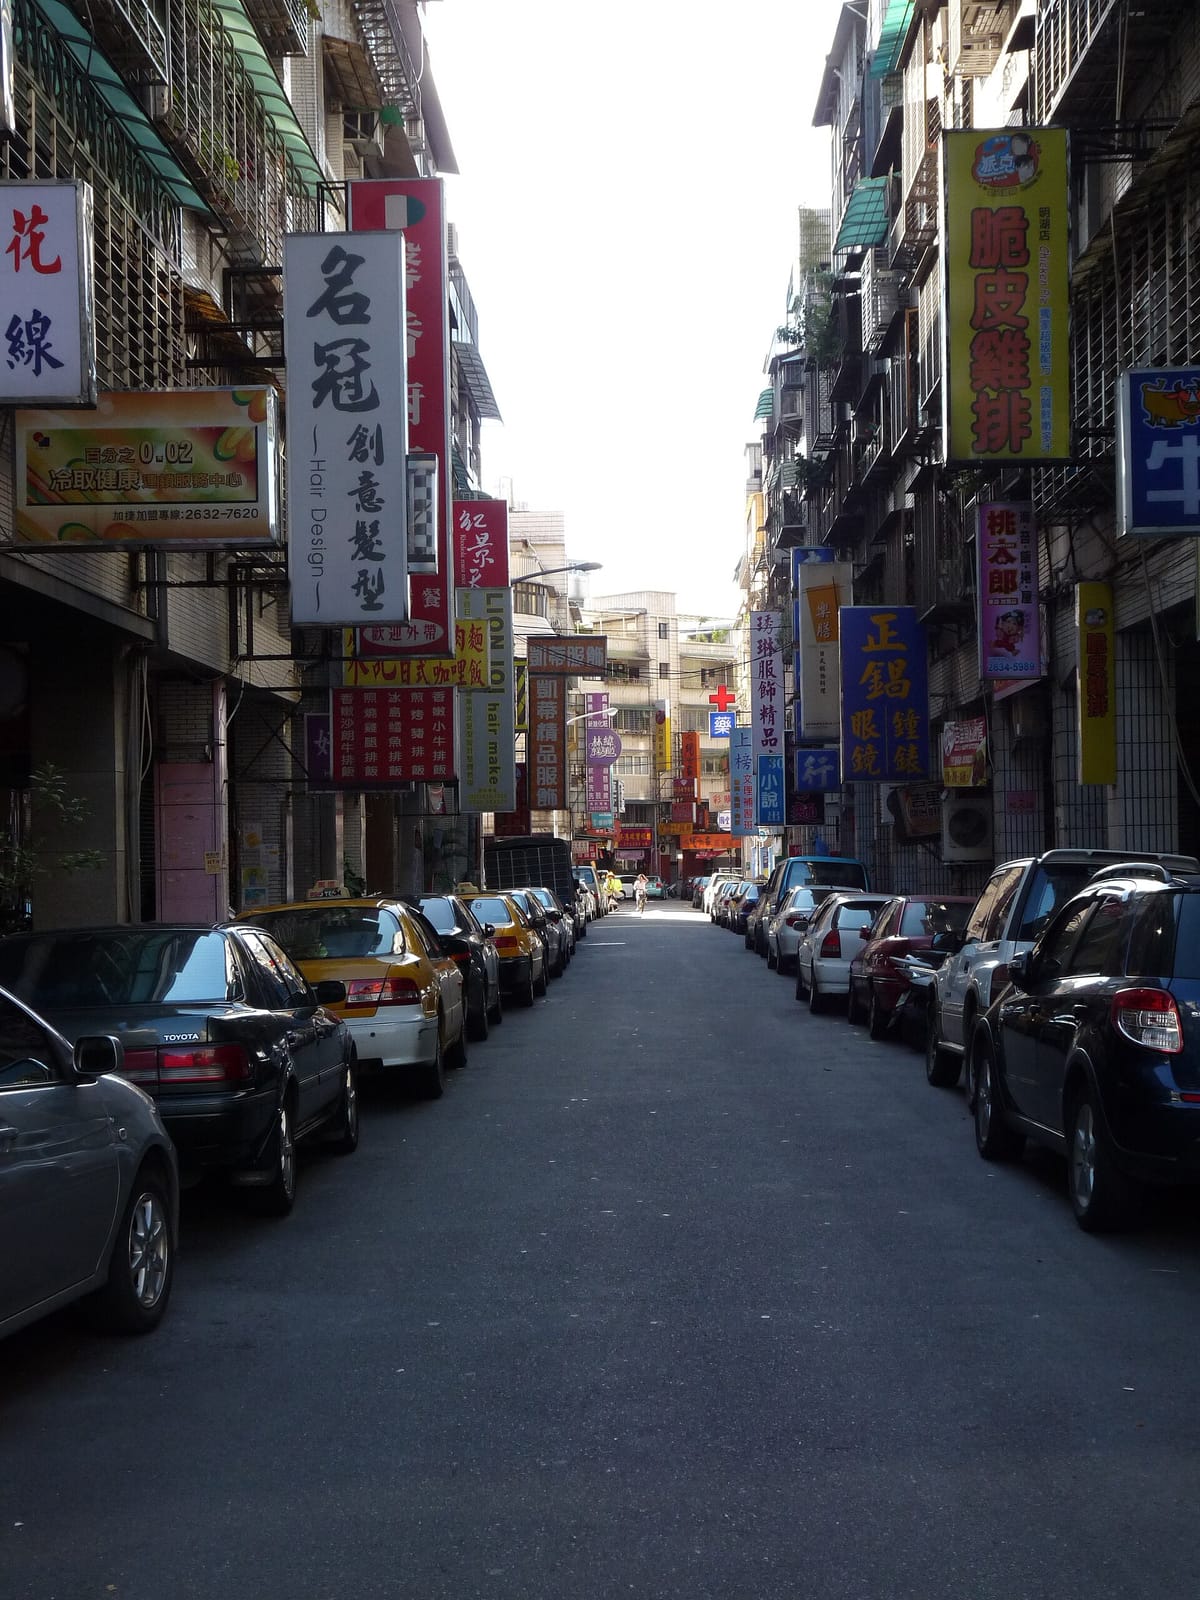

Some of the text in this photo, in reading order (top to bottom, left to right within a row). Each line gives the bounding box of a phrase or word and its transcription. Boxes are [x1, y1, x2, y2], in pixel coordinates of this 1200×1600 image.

[5, 205, 62, 275] 花
[5, 310, 65, 375] 線
[306, 245, 381, 413] 名冠
[969, 206, 1031, 453] 脆皮雞排
[140, 440, 193, 464] 0.02
[1145, 435, 1200, 515] 牛
[308, 460, 327, 577] Hair Design
[346, 423, 386, 611] 創意髮型
[987, 510, 1018, 594] 桃太郎
[487, 702, 501, 735] hair
[851, 709, 881, 776] 眼鏡
[488, 741, 501, 785] make
[164, 1033, 199, 1041] TOYOTA
